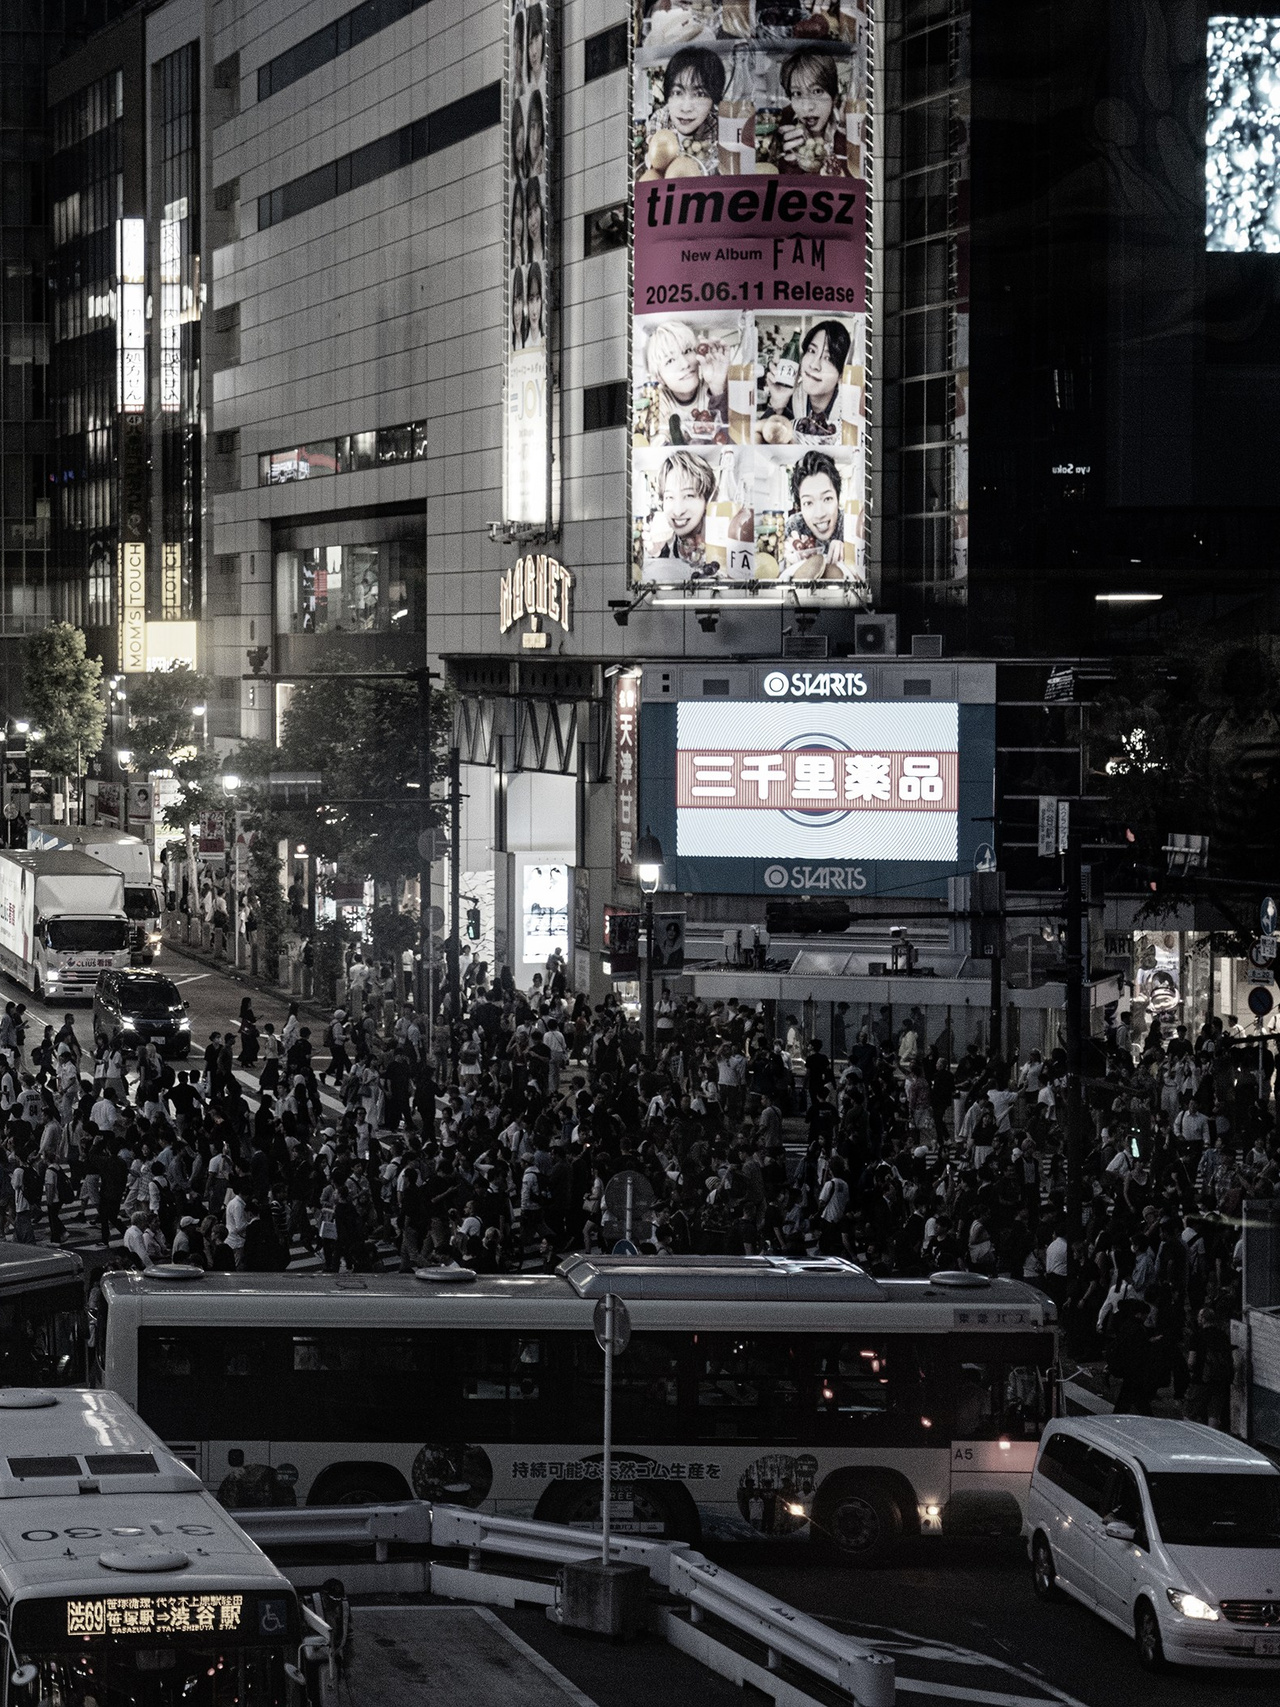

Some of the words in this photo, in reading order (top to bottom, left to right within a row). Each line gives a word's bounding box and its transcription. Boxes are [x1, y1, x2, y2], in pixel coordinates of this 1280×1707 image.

[647, 179, 856, 228] timelesz
[681, 249, 711, 263] New
[715, 247, 763, 261] Album
[646, 281, 764, 306] 2025.06.11
[773, 280, 855, 303] Release
[130, 543, 141, 604] TOUCH
[500, 554, 571, 634] MAGNET
[130, 610, 141, 668] MOM'S
[691, 754, 943, 801] 三千里薬品
[954, 1448, 973, 1460] A5
[69, 1601, 104, 1632] 渋69
